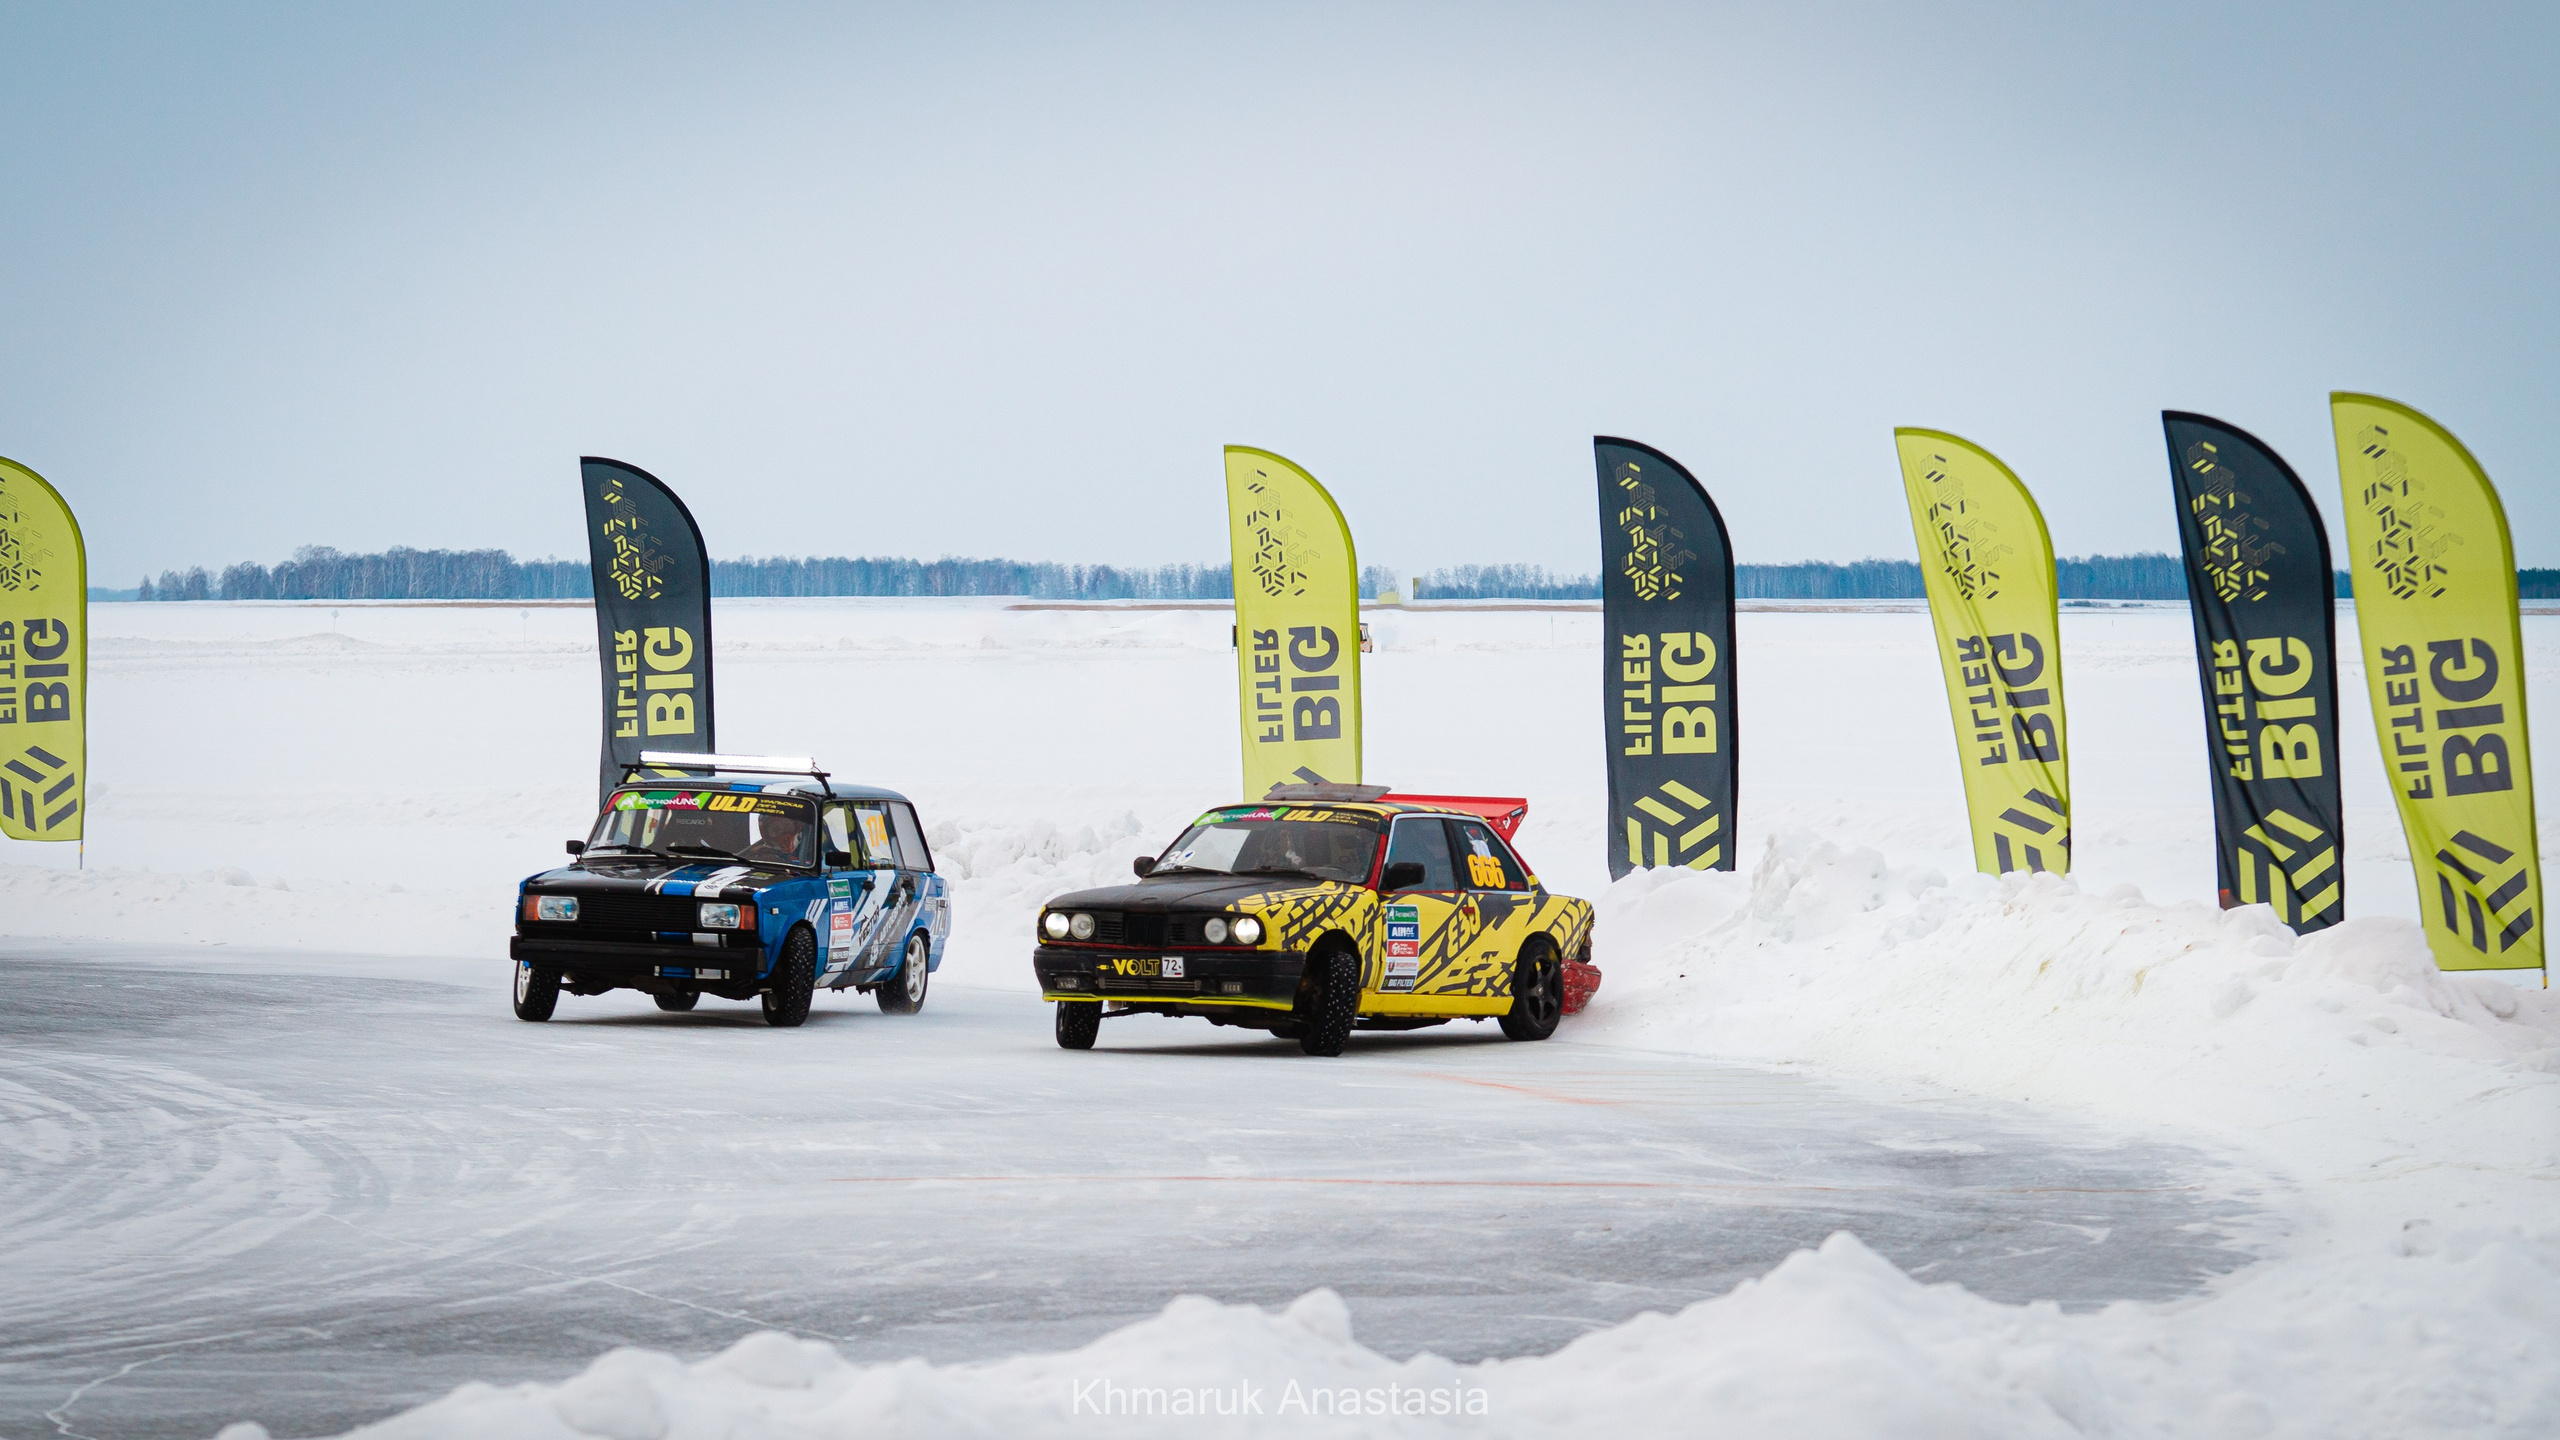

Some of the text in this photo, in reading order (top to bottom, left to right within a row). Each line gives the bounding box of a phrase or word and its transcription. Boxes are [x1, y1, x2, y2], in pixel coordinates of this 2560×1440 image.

[708, 795, 758, 812] ULD
[1283, 810, 1334, 822] ULD
[866, 814, 888, 847] 174
[1467, 854, 1506, 889] 666
[1113, 959, 1160, 976] VOLT
[1164, 959, 1178, 971] 72
